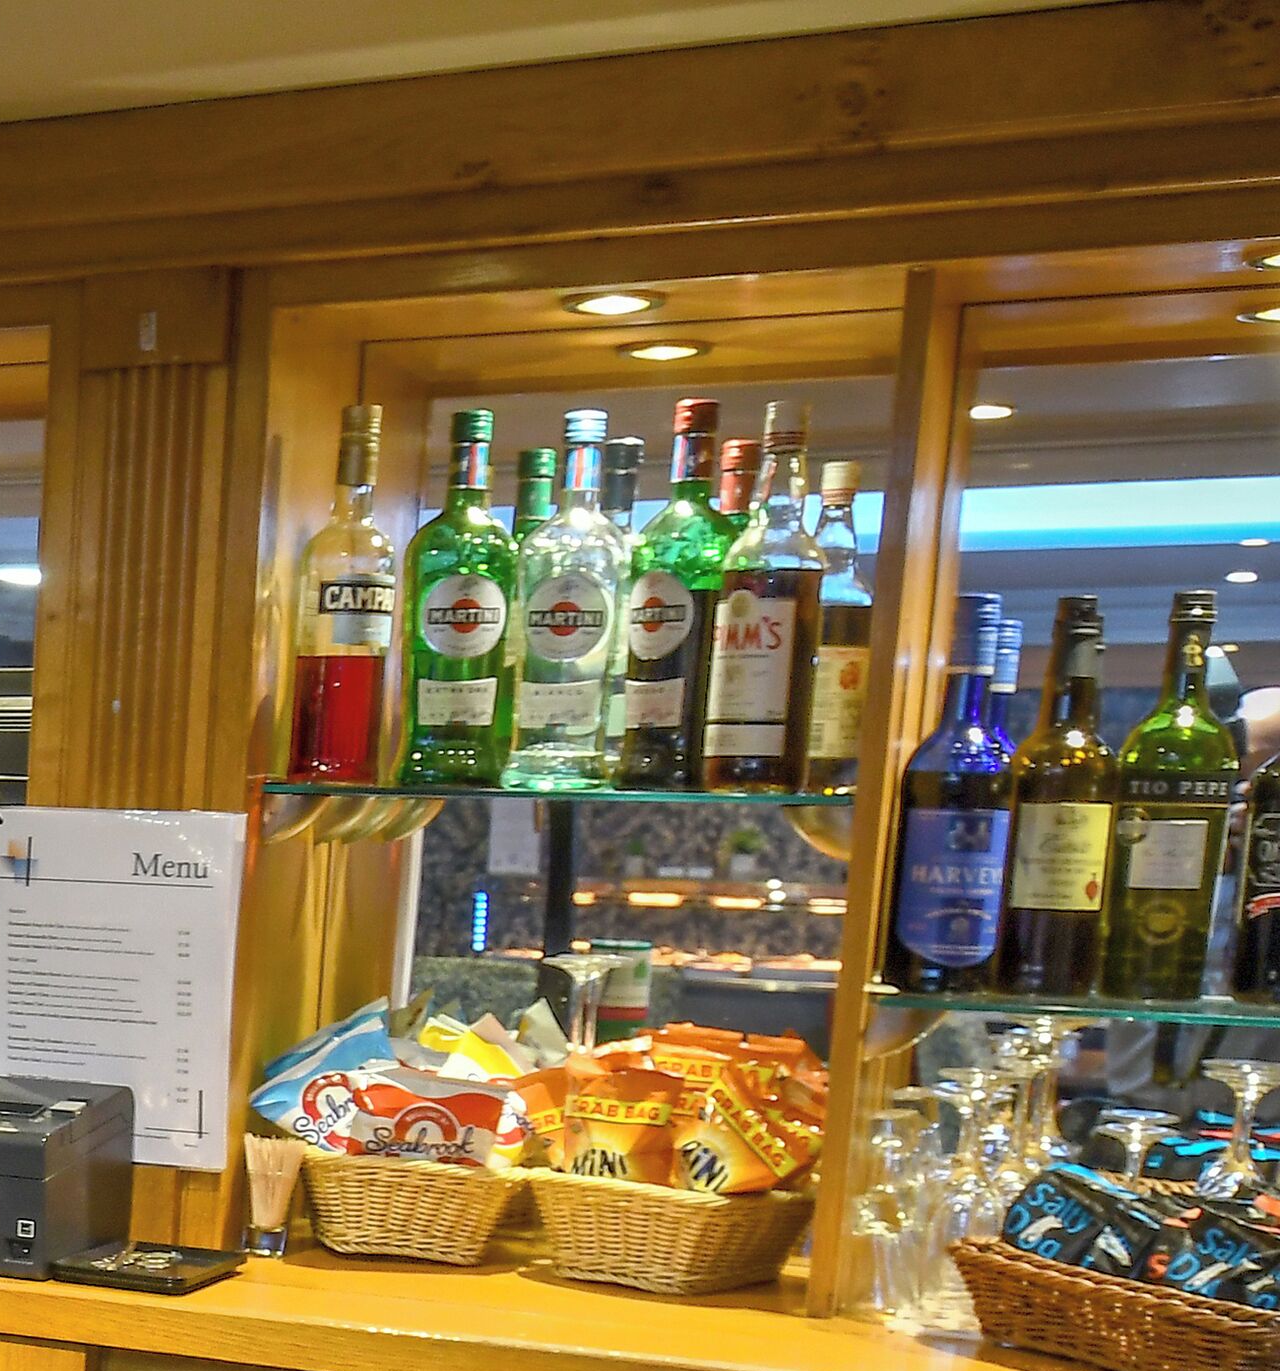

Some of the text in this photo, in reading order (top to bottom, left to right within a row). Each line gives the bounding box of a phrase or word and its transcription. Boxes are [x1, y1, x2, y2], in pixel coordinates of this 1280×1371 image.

[430, 608, 500, 624] MARTINI
[530, 611, 603, 627] MARTINI
[131, 853, 209, 879] Menu
[293, 1094, 355, 1145] Seabr
[365, 1125, 476, 1155] Seabrook
